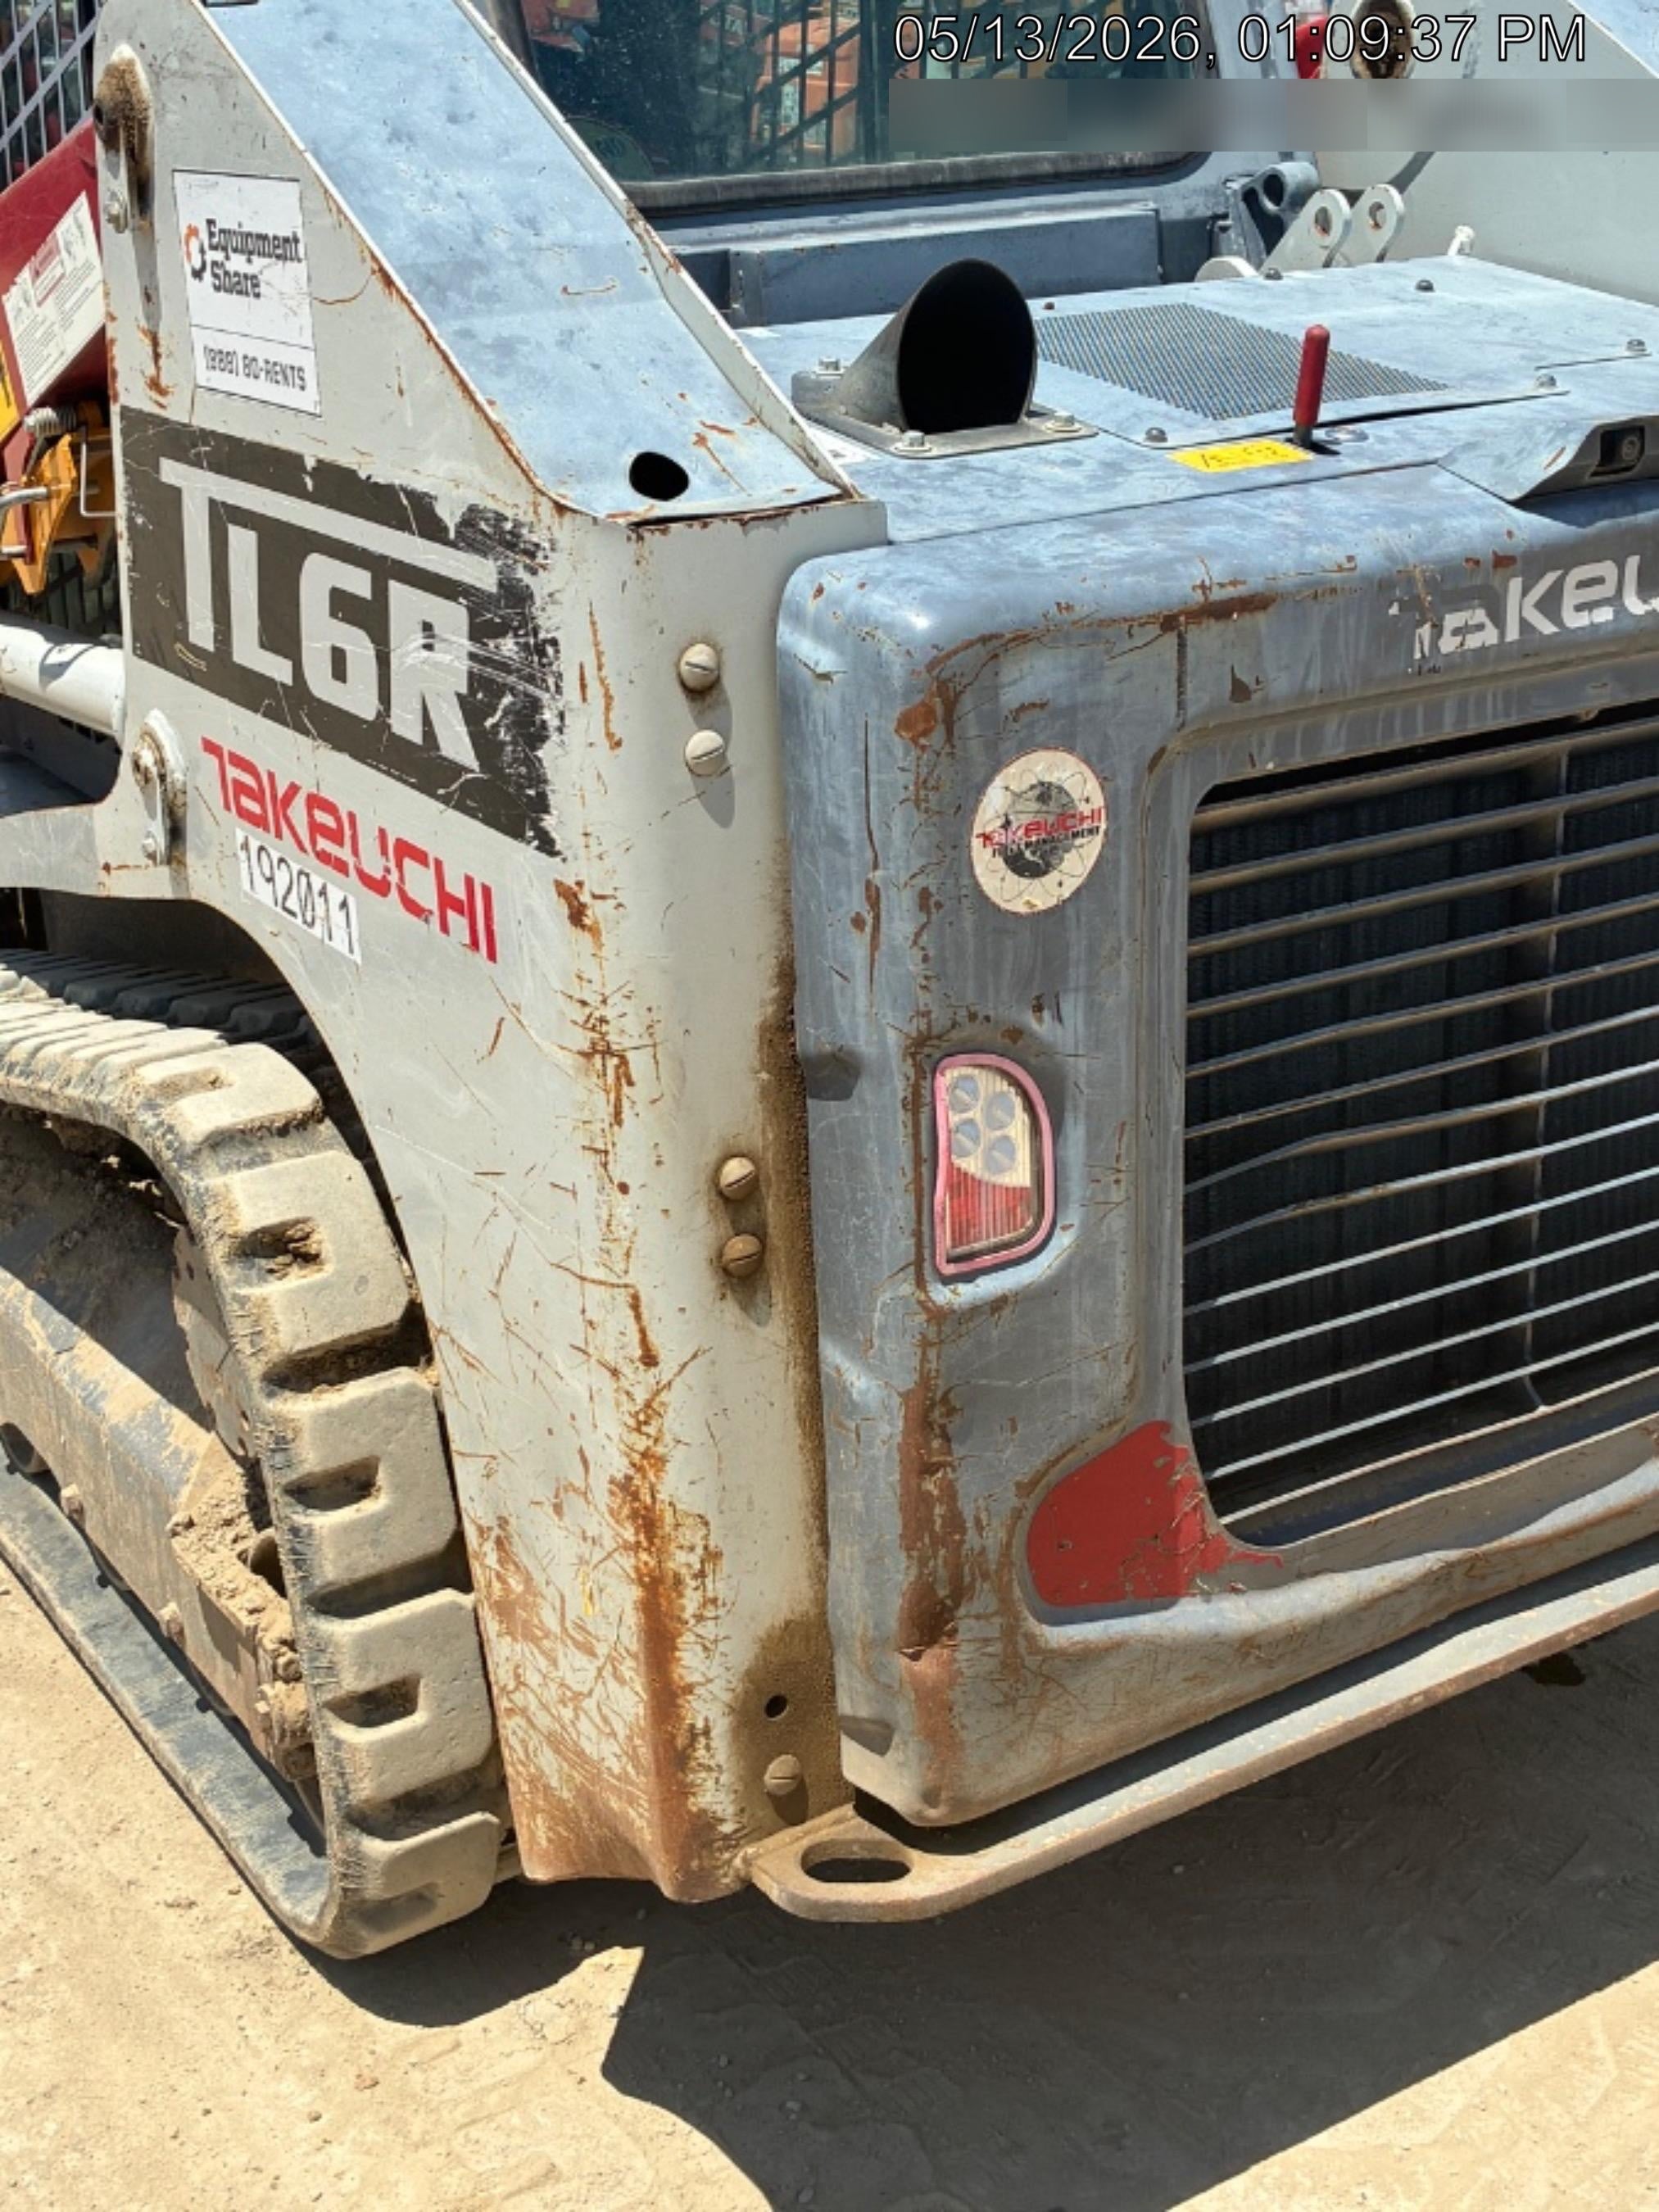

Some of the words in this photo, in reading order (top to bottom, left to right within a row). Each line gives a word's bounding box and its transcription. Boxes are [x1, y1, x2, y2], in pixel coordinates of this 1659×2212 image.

[206, 218, 303, 264] Equipment
[210, 260, 261, 299] Share
[159, 456, 496, 772] TL6R
[201, 736, 497, 964] TAKEUCHI
[240, 834, 355, 955] 192011
